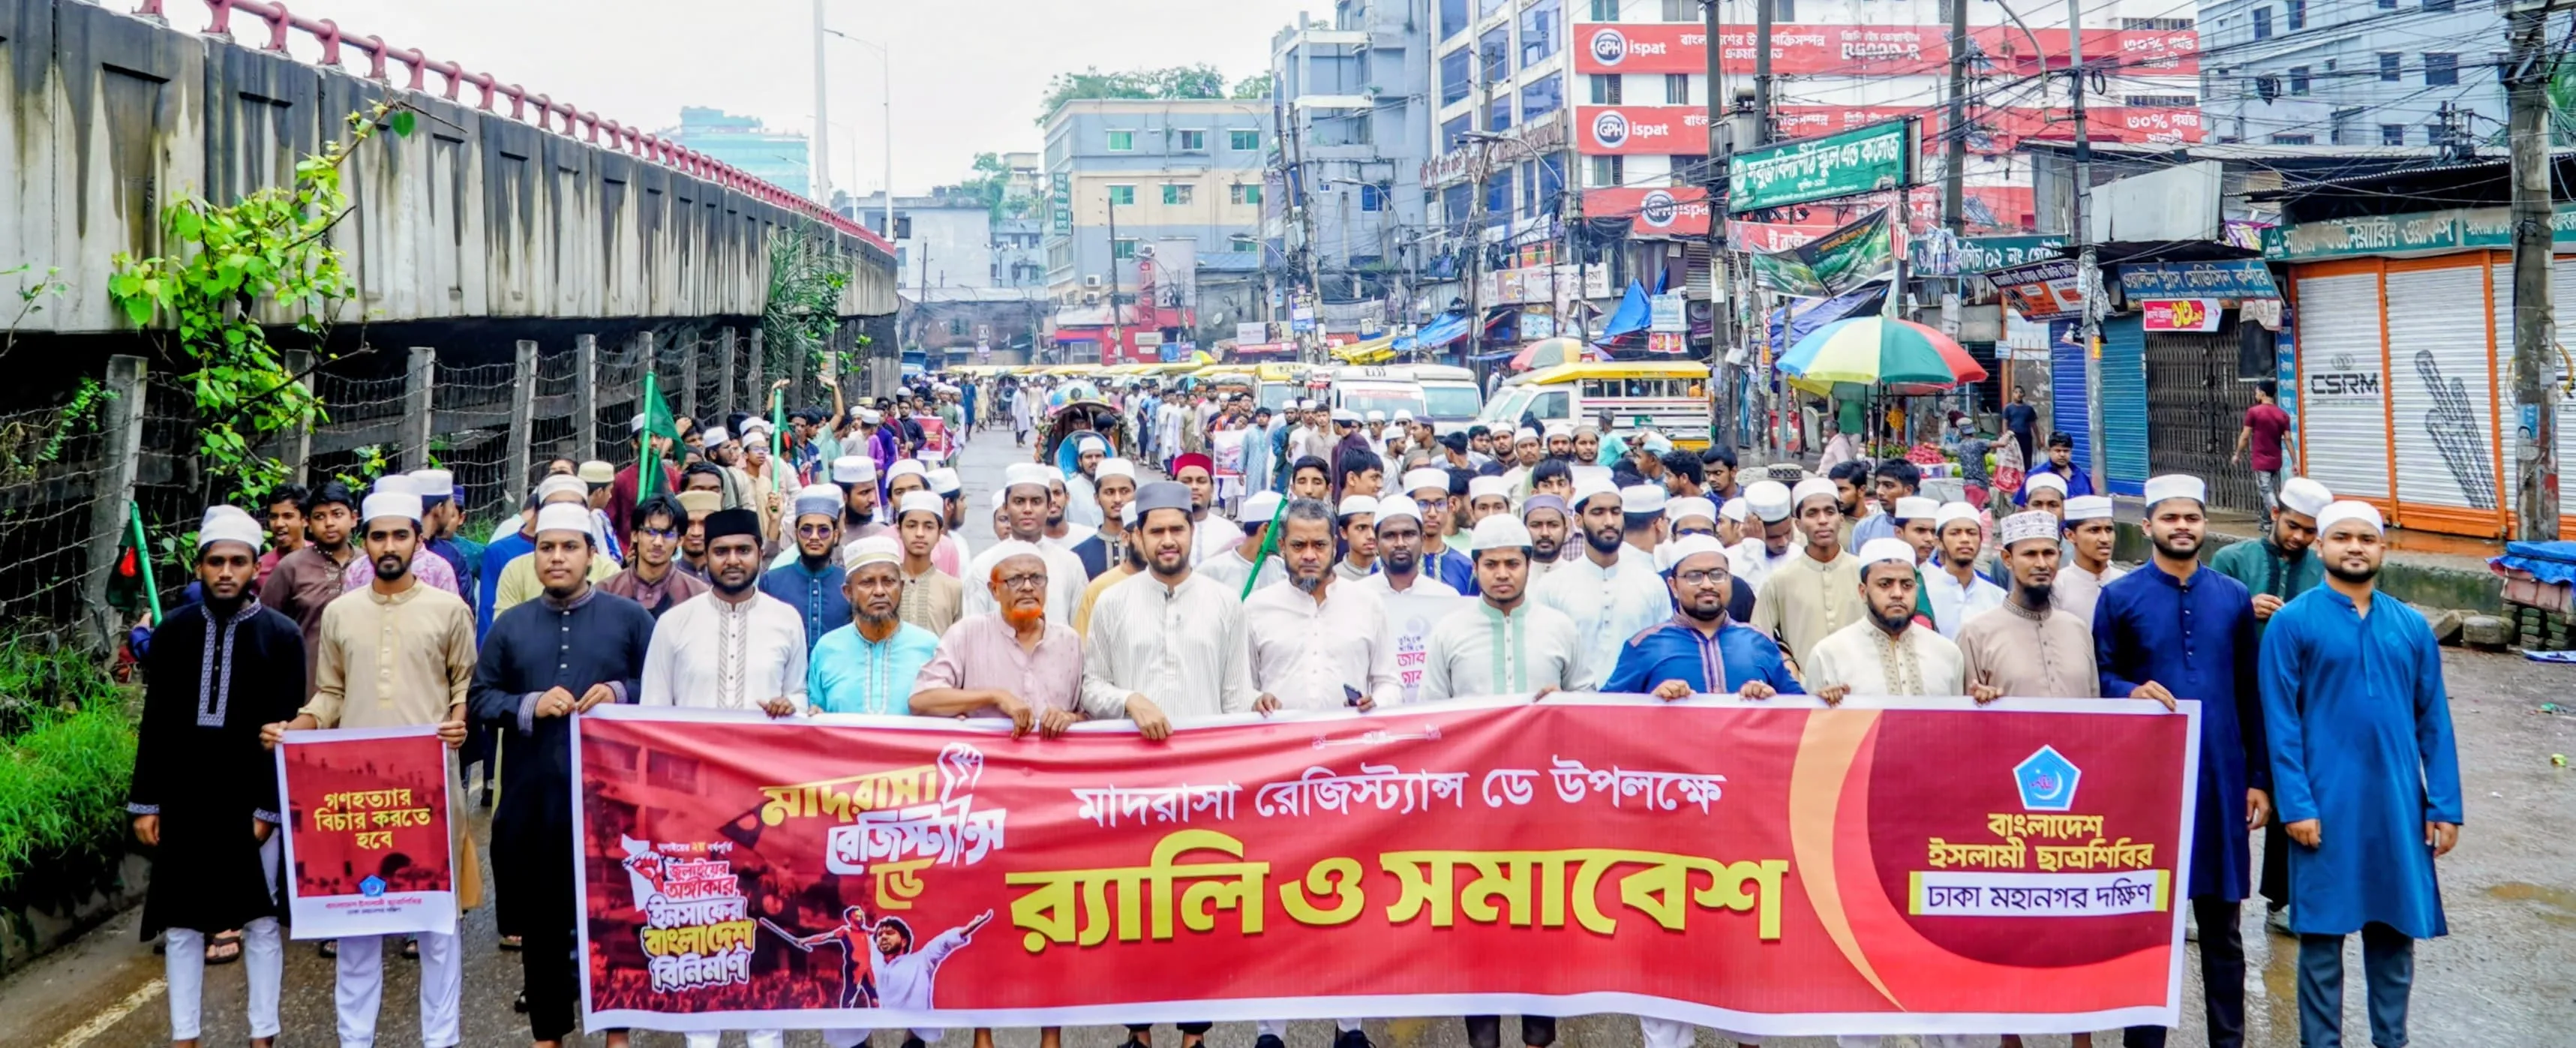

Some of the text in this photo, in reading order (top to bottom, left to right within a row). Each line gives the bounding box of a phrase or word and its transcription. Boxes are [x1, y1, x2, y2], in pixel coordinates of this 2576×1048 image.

[1596, 40, 1666, 57] GPH ispat
[1599, 122, 1623, 138] GPH
[1632, 121, 1669, 139] ispat
[2310, 372, 2379, 395] CSRM
[323, 788, 412, 811] গণহত্যার
[758, 764, 937, 827] মাদরাসা
[1073, 755, 1728, 827] মাদরাসা রেজিস্ট্যান্স ডে উপলক্ষে
[314, 806, 431, 832] বিচার করতে
[1987, 812, 2104, 839] বাংলাদেশ
[355, 829, 393, 849] হবে
[1928, 836, 2155, 873] ইসলামী ছাত্রশিবির
[869, 857, 937, 910] ডে
[1279, 857, 1365, 925] ও
[1379, 848, 1788, 941] সমাবেশ
[1927, 878, 2153, 911] ঢাকা মহানগর দক্ষিণ
[643, 919, 755, 956] বাংলাদেশ
